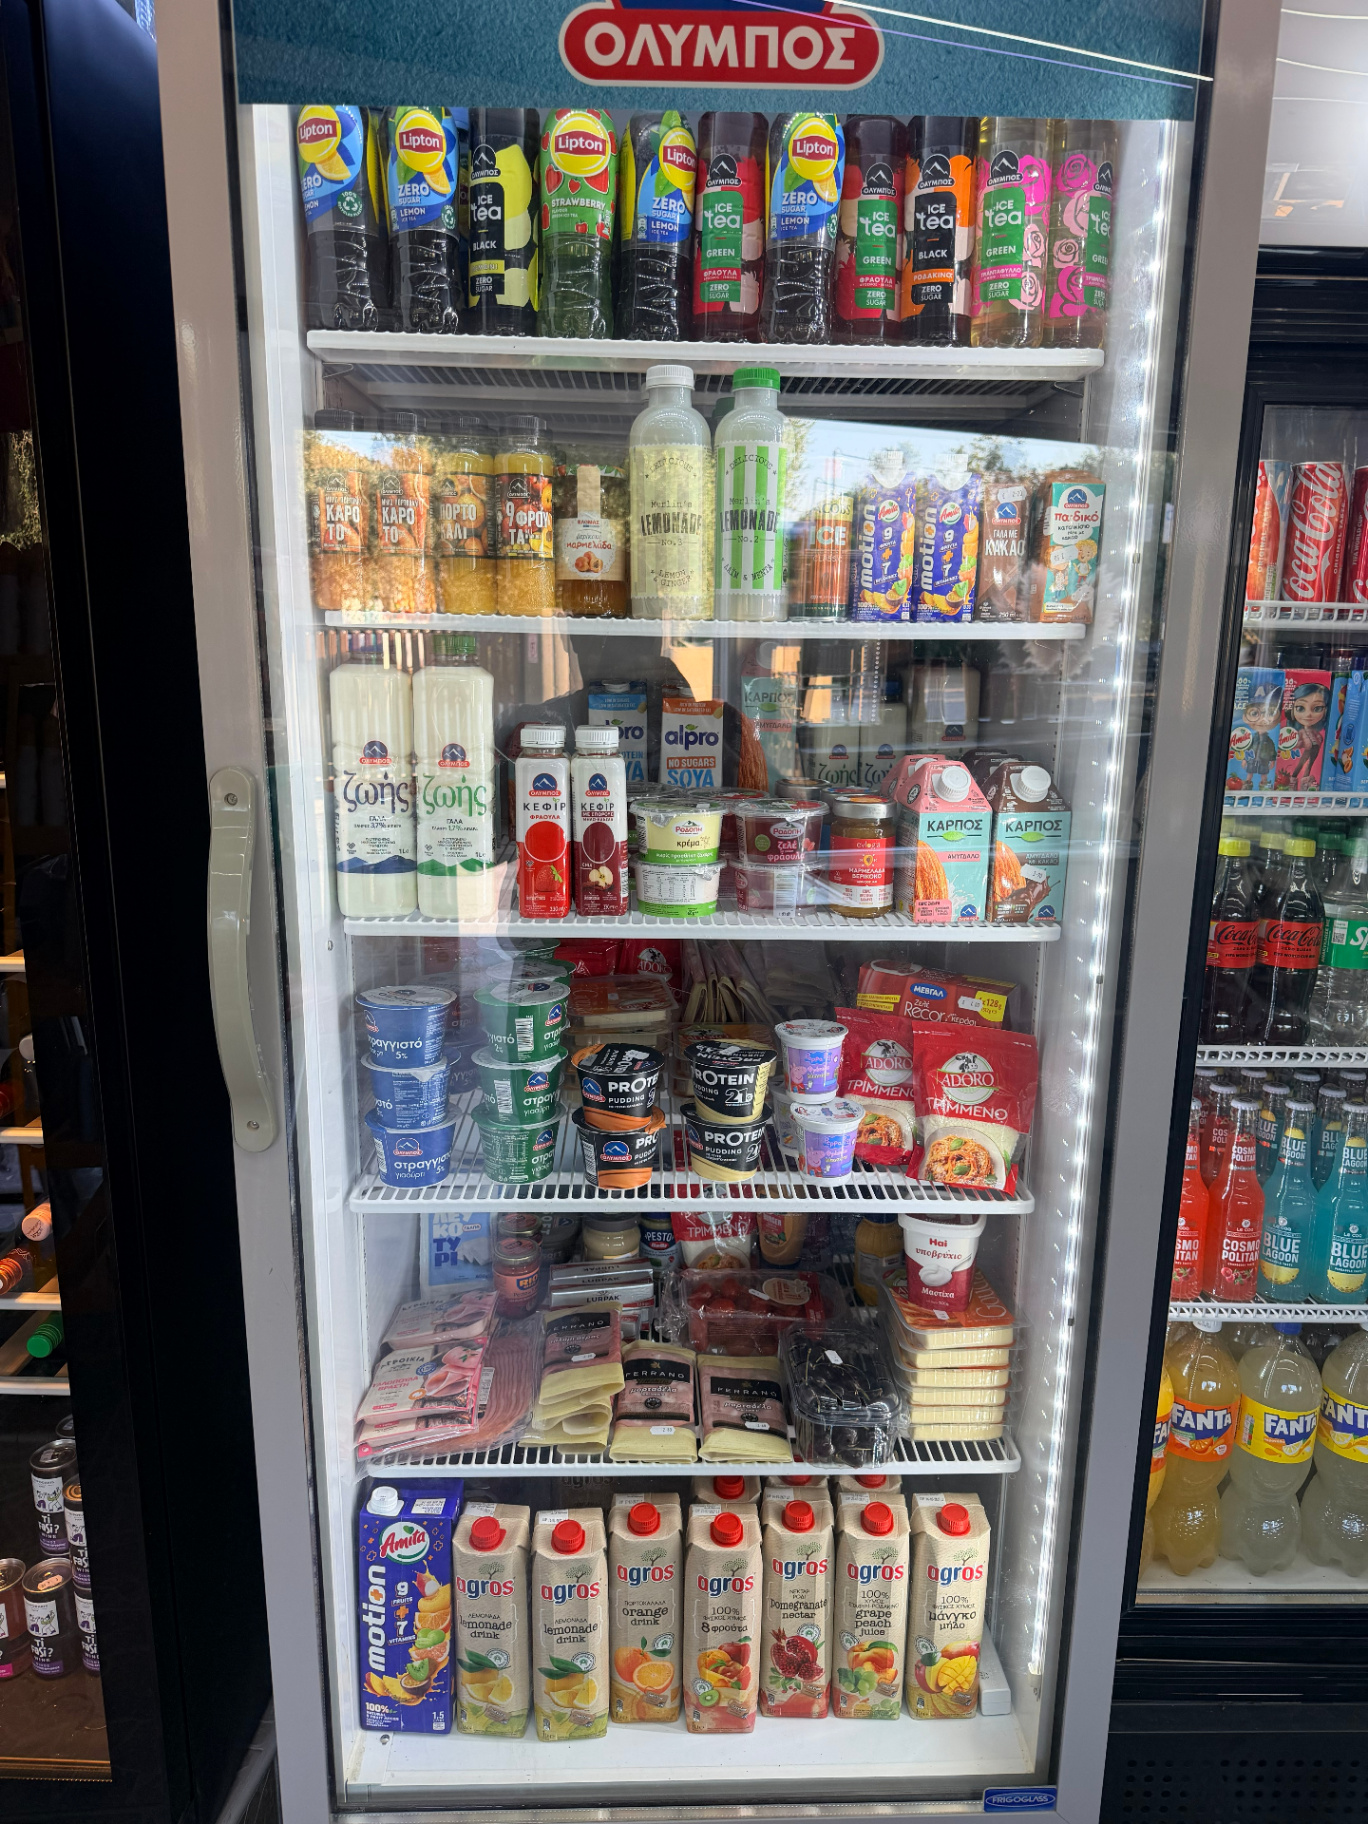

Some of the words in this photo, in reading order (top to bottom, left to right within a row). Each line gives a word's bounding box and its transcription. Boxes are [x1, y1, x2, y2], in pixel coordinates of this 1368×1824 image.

[584, 21, 855, 71] ΟΛΥΜΠΟΣ
[299, 123, 333, 140] Lipton
[403, 134, 440, 148] Lipton
[558, 136, 603, 152] Lipton
[796, 140, 833, 156] Lipton
[667, 148, 697, 168] Lipton
[398, 183, 430, 197] ZERO
[399, 196, 421, 204] SUGAR
[478, 195, 493, 204] ICE
[551, 197, 606, 211] STRAWBERRY
[782, 191, 818, 205] ZERO
[652, 197, 686, 214] ZERO
[715, 203, 732, 213] ICE
[781, 204, 806, 213] SUGAR
[927, 204, 946, 214] ICE
[996, 200, 1014, 210] ICE
[400, 207, 426, 217] LEMON
[470, 204, 502, 221] tea
[651, 210, 677, 220] SUGAR
[872, 211, 889, 221] ICE
[985, 209, 1022, 228] tea
[703, 210, 741, 229] tea
[781, 216, 810, 225] LEMON
[915, 212, 954, 231] tea
[651, 221, 679, 232] LEMON
[860, 217, 896, 238] tea
[472, 240, 497, 251] BLACK
[986, 245, 1016, 258] GREEN
[706, 248, 735, 258] GREEN
[918, 249, 947, 259] BLACK
[862, 256, 892, 266] GREEN
[476, 276, 493, 285] ZERO
[989, 281, 1009, 291] ZERO
[710, 283, 730, 292] ZERO
[921, 284, 942, 293] ZERO
[988, 290, 1009, 298] SUGAR
[709, 291, 730, 299] SUGAR
[866, 291, 887, 299] ZERO
[920, 293, 942, 301] SUGAR
[866, 298, 887, 306] SUGAR
[729, 454, 774, 472] DELICIOUS
[326, 504, 360, 523] ΚΑΡΟ
[382, 507, 415, 525] ΚΑΡΟ
[939, 506, 961, 523] Amita
[640, 513, 703, 537] LEMONADE
[719, 509, 781, 533] LEMONADE
[327, 523, 344, 541] ΤΟ
[383, 527, 399, 543] ΤΟ
[883, 526, 893, 540] 9
[944, 529, 955, 543] 9
[1008, 529, 1018, 538] ΜΕ
[1282, 463, 1342, 602] Coca-Cola
[861, 504, 876, 589] motion
[1354, 529, 1362, 551] WORLD
[921, 507, 938, 591] motion
[985, 539, 1026, 556] ΚΑΚΑΟ
[1333, 534, 1342, 575] ORIGINAL
[882, 561, 892, 576] 7
[942, 563, 952, 577] 7
[665, 724, 719, 751] alpro
[668, 759, 681, 768] NO
[681, 757, 715, 768] SUGARS
[667, 769, 715, 788] SOYA
[343, 770, 409, 814] ζωής
[422, 773, 487, 817] ζωής
[927, 819, 983, 832] ΚΑΡΠΟΣ
[1005, 820, 1063, 832] ΚΑΡΠΟΣ
[676, 838, 700, 848] κρέμα
[778, 840, 798, 851] ζελέ
[767, 853, 805, 865] φράουλα
[913, 985, 944, 998] ΜΕΒΓΑΛ
[395, 1051, 408, 1059] 5%
[866, 1056, 913, 1071] ADORO
[941, 1071, 995, 1088] ADORO
[608, 1094, 645, 1103] PUDDING
[705, 1146, 742, 1155] PUDDING
[432, 1223, 463, 1237] ΚΟ
[646, 1231, 672, 1242] PESTO
[433, 1237, 461, 1252] ΤΥ
[929, 1237, 948, 1247] Hai
[1223, 1238, 1260, 1251] COSMO
[1263, 1231, 1300, 1254] BLUE
[915, 1247, 963, 1261] υποβρύχιο
[1221, 1250, 1259, 1263] POLITAN
[1262, 1249, 1299, 1263] LAGOON
[1331, 1241, 1368, 1259] BLUE
[434, 1252, 458, 1266] ΡΙ
[1330, 1255, 1367, 1270] LAGOON
[586, 1295, 620, 1303] LURPAK
[921, 1286, 955, 1299] Μαστίχα
[717, 1387, 777, 1398] FERRANO
[1171, 1403, 1232, 1431] FANTA
[1264, 1412, 1318, 1437] FANTA
[380, 1529, 426, 1558] Amita
[617, 1564, 675, 1587] agros
[772, 1558, 828, 1580] agros
[847, 1562, 904, 1585] agros
[927, 1564, 983, 1586] agros
[396, 1581, 409, 1596] 9
[456, 1576, 514, 1599] agros
[697, 1574, 754, 1598] agros
[541, 1581, 600, 1605] agros
[861, 1589, 890, 1599] 100%
[392, 1597, 413, 1605] FRUITS
[941, 1595, 969, 1605] 100%
[622, 1607, 669, 1619] orange
[711, 1605, 740, 1616] 100%
[782, 1610, 816, 1619] nectar
[855, 1609, 892, 1619] grape
[928, 1609, 977, 1622] μάνγκο
[362, 1565, 386, 1671] motion
[460, 1614, 512, 1630] lemonade
[630, 1617, 660, 1627] drink
[854, 1618, 891, 1629] peach
[396, 1620, 408, 1636] 7
[544, 1623, 599, 1636] lemonade
[701, 1621, 710, 1634] 8
[711, 1622, 748, 1633] φρούτα
[859, 1627, 886, 1637] juice
[939, 1622, 966, 1631] μήλο
[388, 1634, 416, 1644] VITAMINS
[470, 1630, 500, 1639] drink
[556, 1635, 586, 1644] drink
[366, 1702, 389, 1713] 100%
[992, 1794, 1049, 1805] FRIGOGLASS
